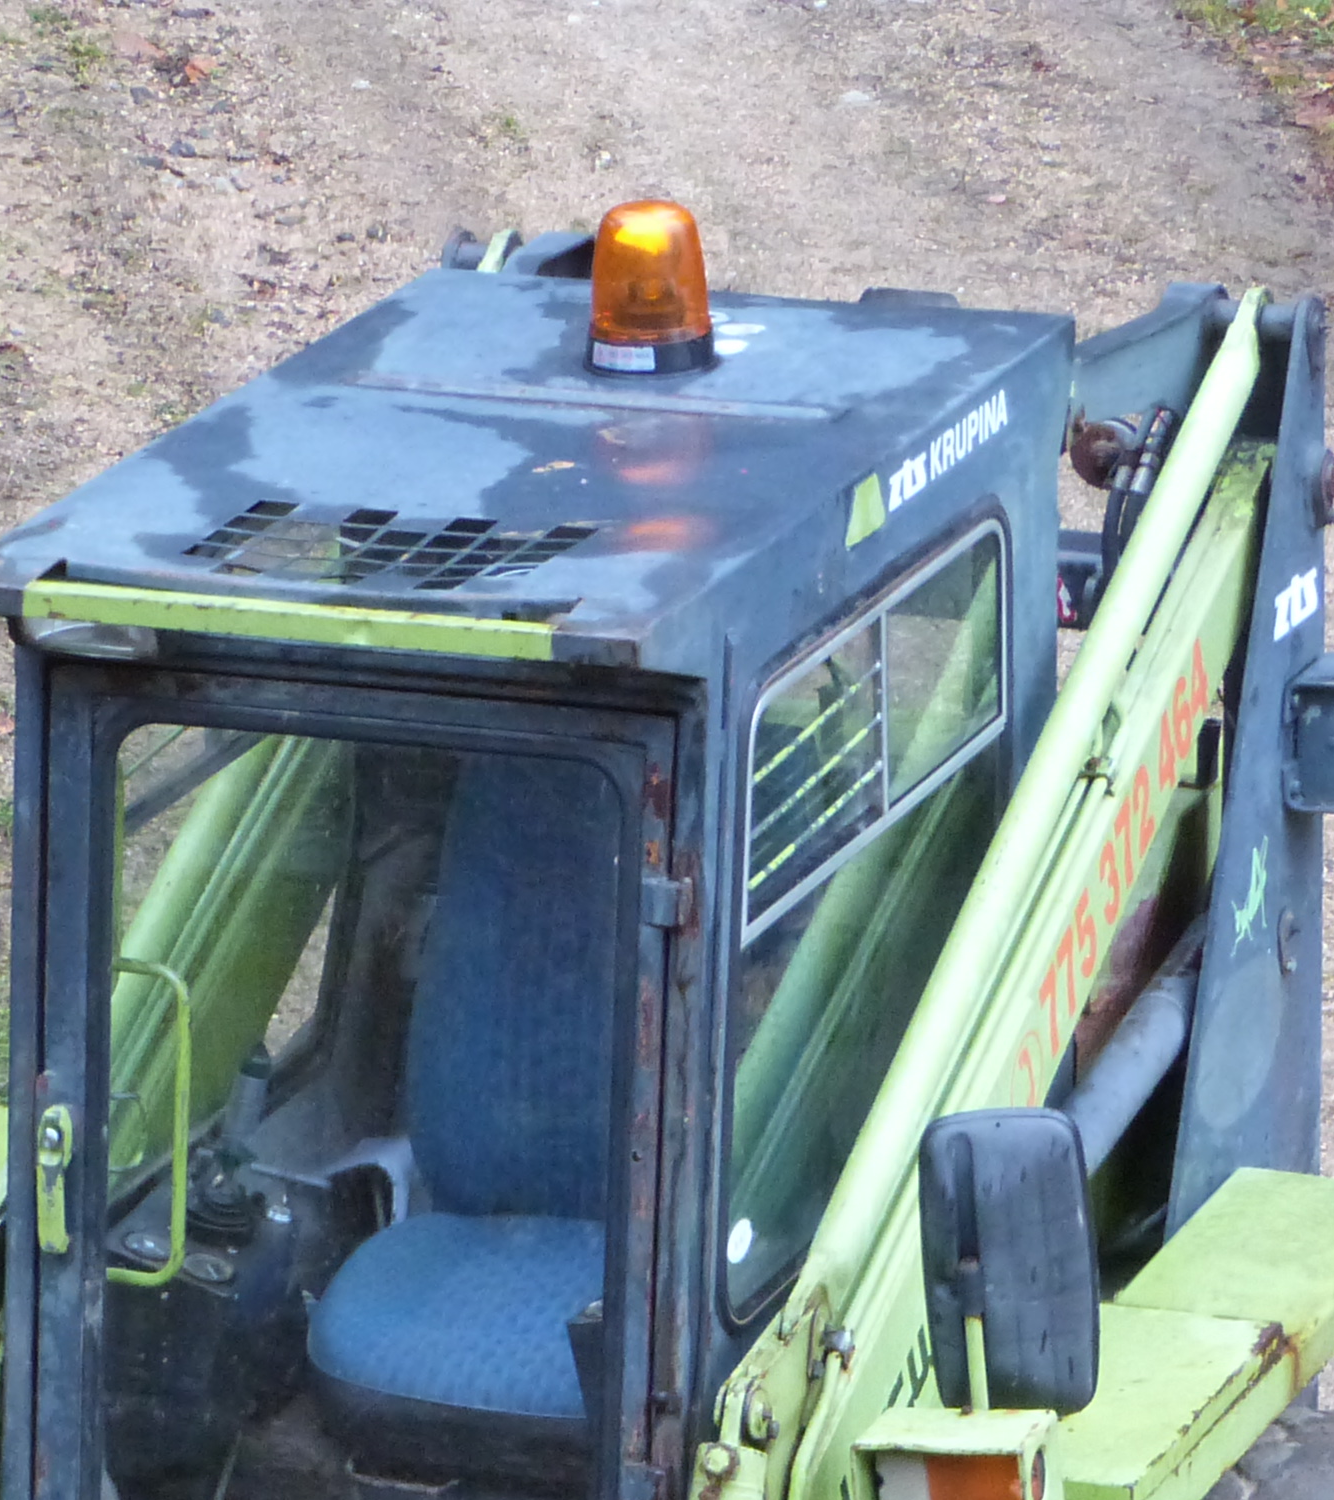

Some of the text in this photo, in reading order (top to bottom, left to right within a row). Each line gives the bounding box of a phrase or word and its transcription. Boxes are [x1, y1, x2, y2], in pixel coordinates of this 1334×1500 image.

[929, 388, 1009, 481] KRUPINA
[1039, 637, 1209, 1058] 775 372 464
